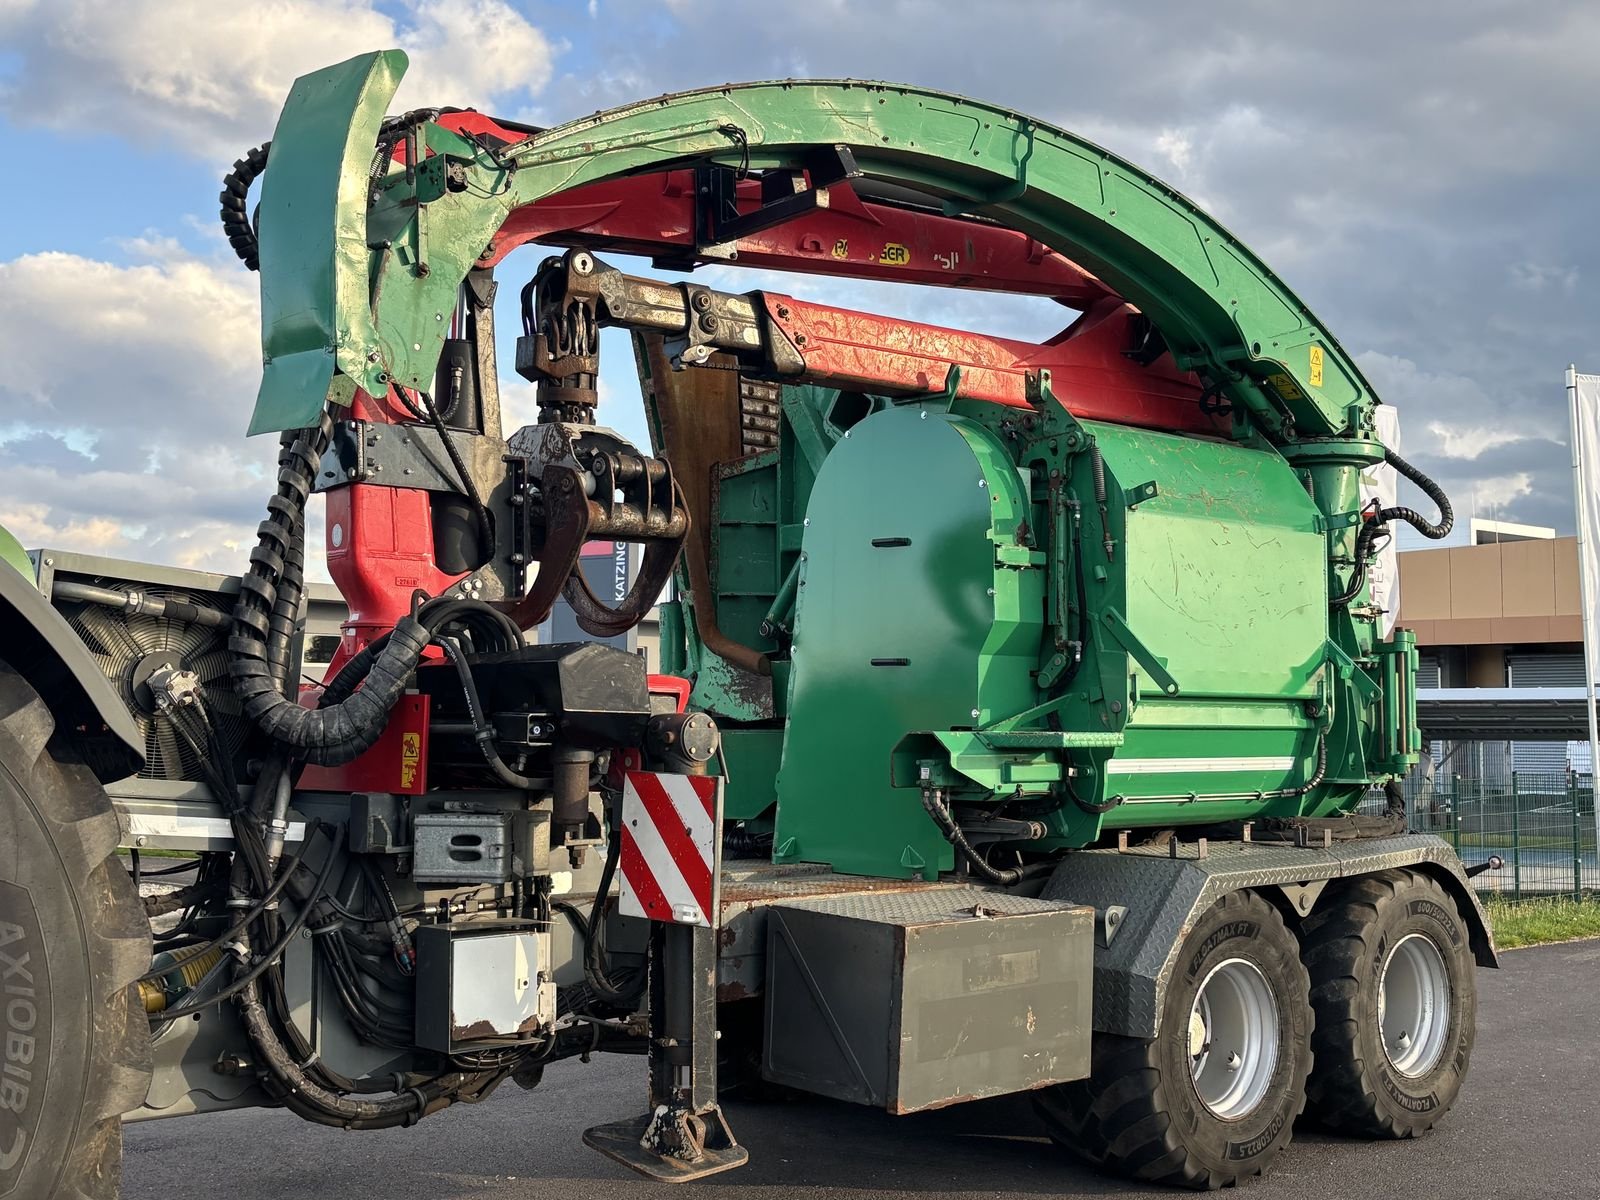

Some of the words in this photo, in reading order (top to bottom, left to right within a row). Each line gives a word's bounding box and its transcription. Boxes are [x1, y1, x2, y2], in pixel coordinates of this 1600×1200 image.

[1193, 923, 1235, 970] FLOATMAX
[1237, 922, 1249, 935] FT
[0, 921, 37, 1115] AXIOBIB
[1383, 1078, 1394, 1091] FT
[1392, 1092, 1430, 1111] FLOATMAX
